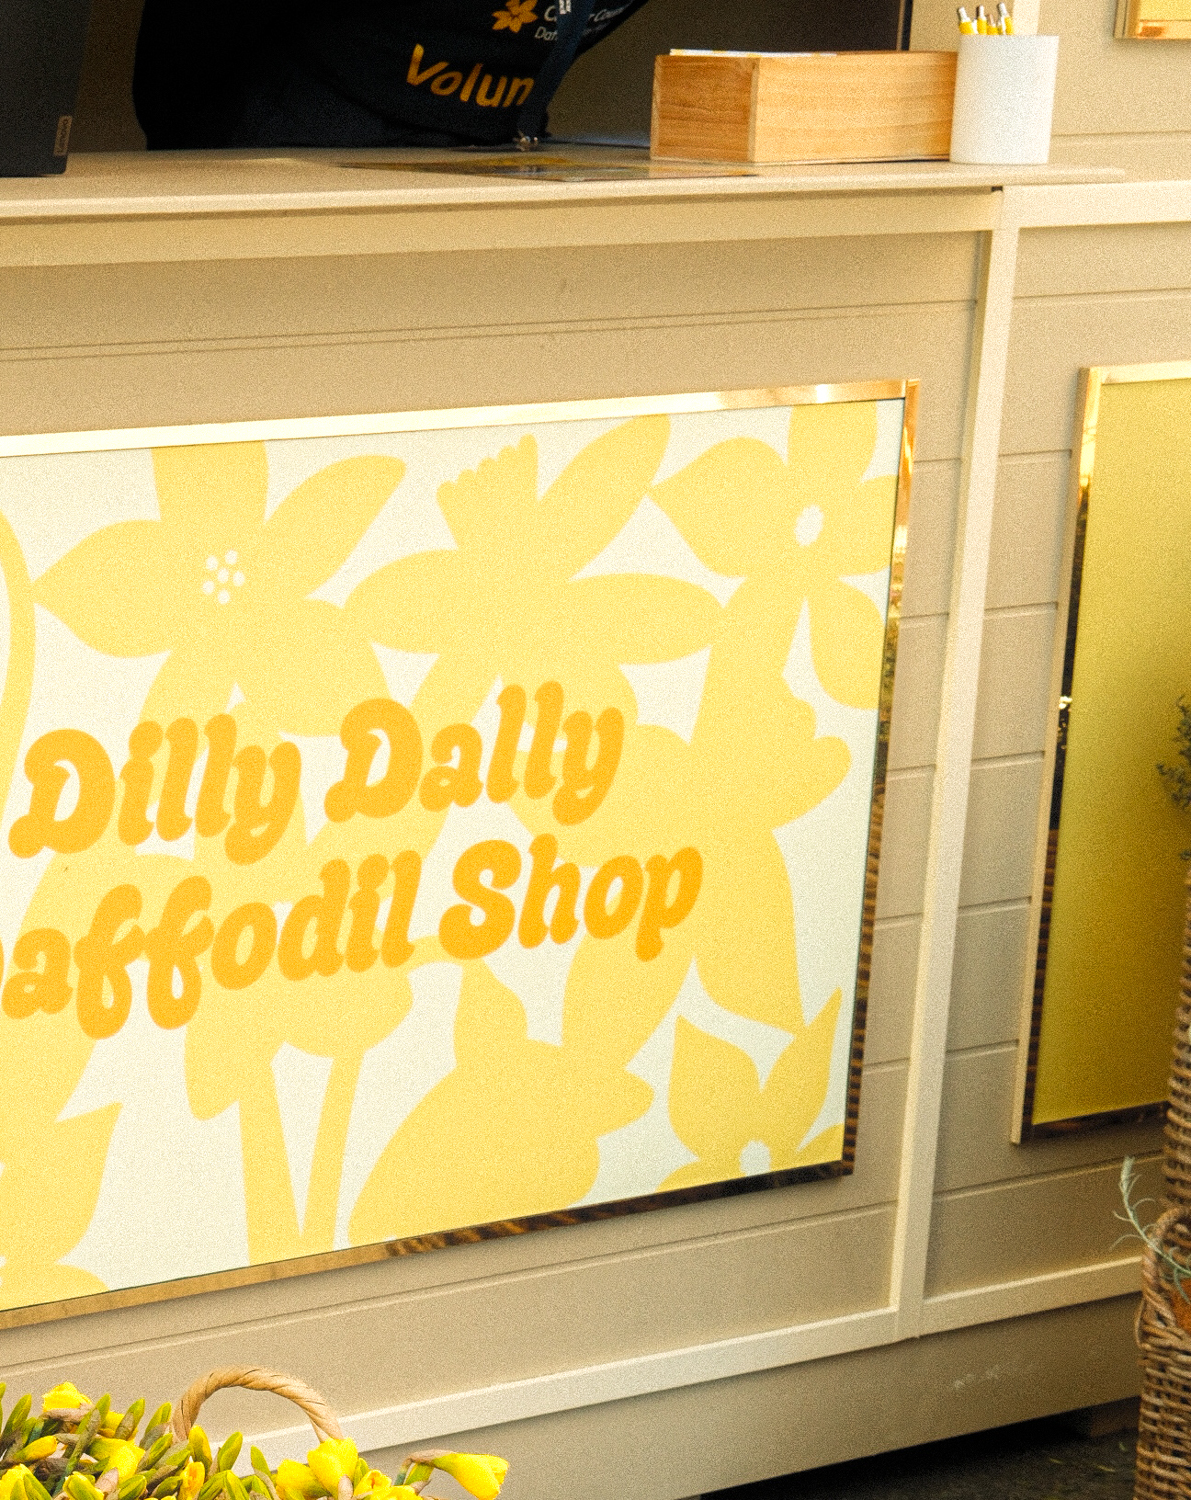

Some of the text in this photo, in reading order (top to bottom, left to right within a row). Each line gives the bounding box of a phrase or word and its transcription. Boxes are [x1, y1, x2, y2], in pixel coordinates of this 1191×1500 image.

[7, 681, 624, 865] Dilly Dally
[438, 833, 703, 962] Shop
